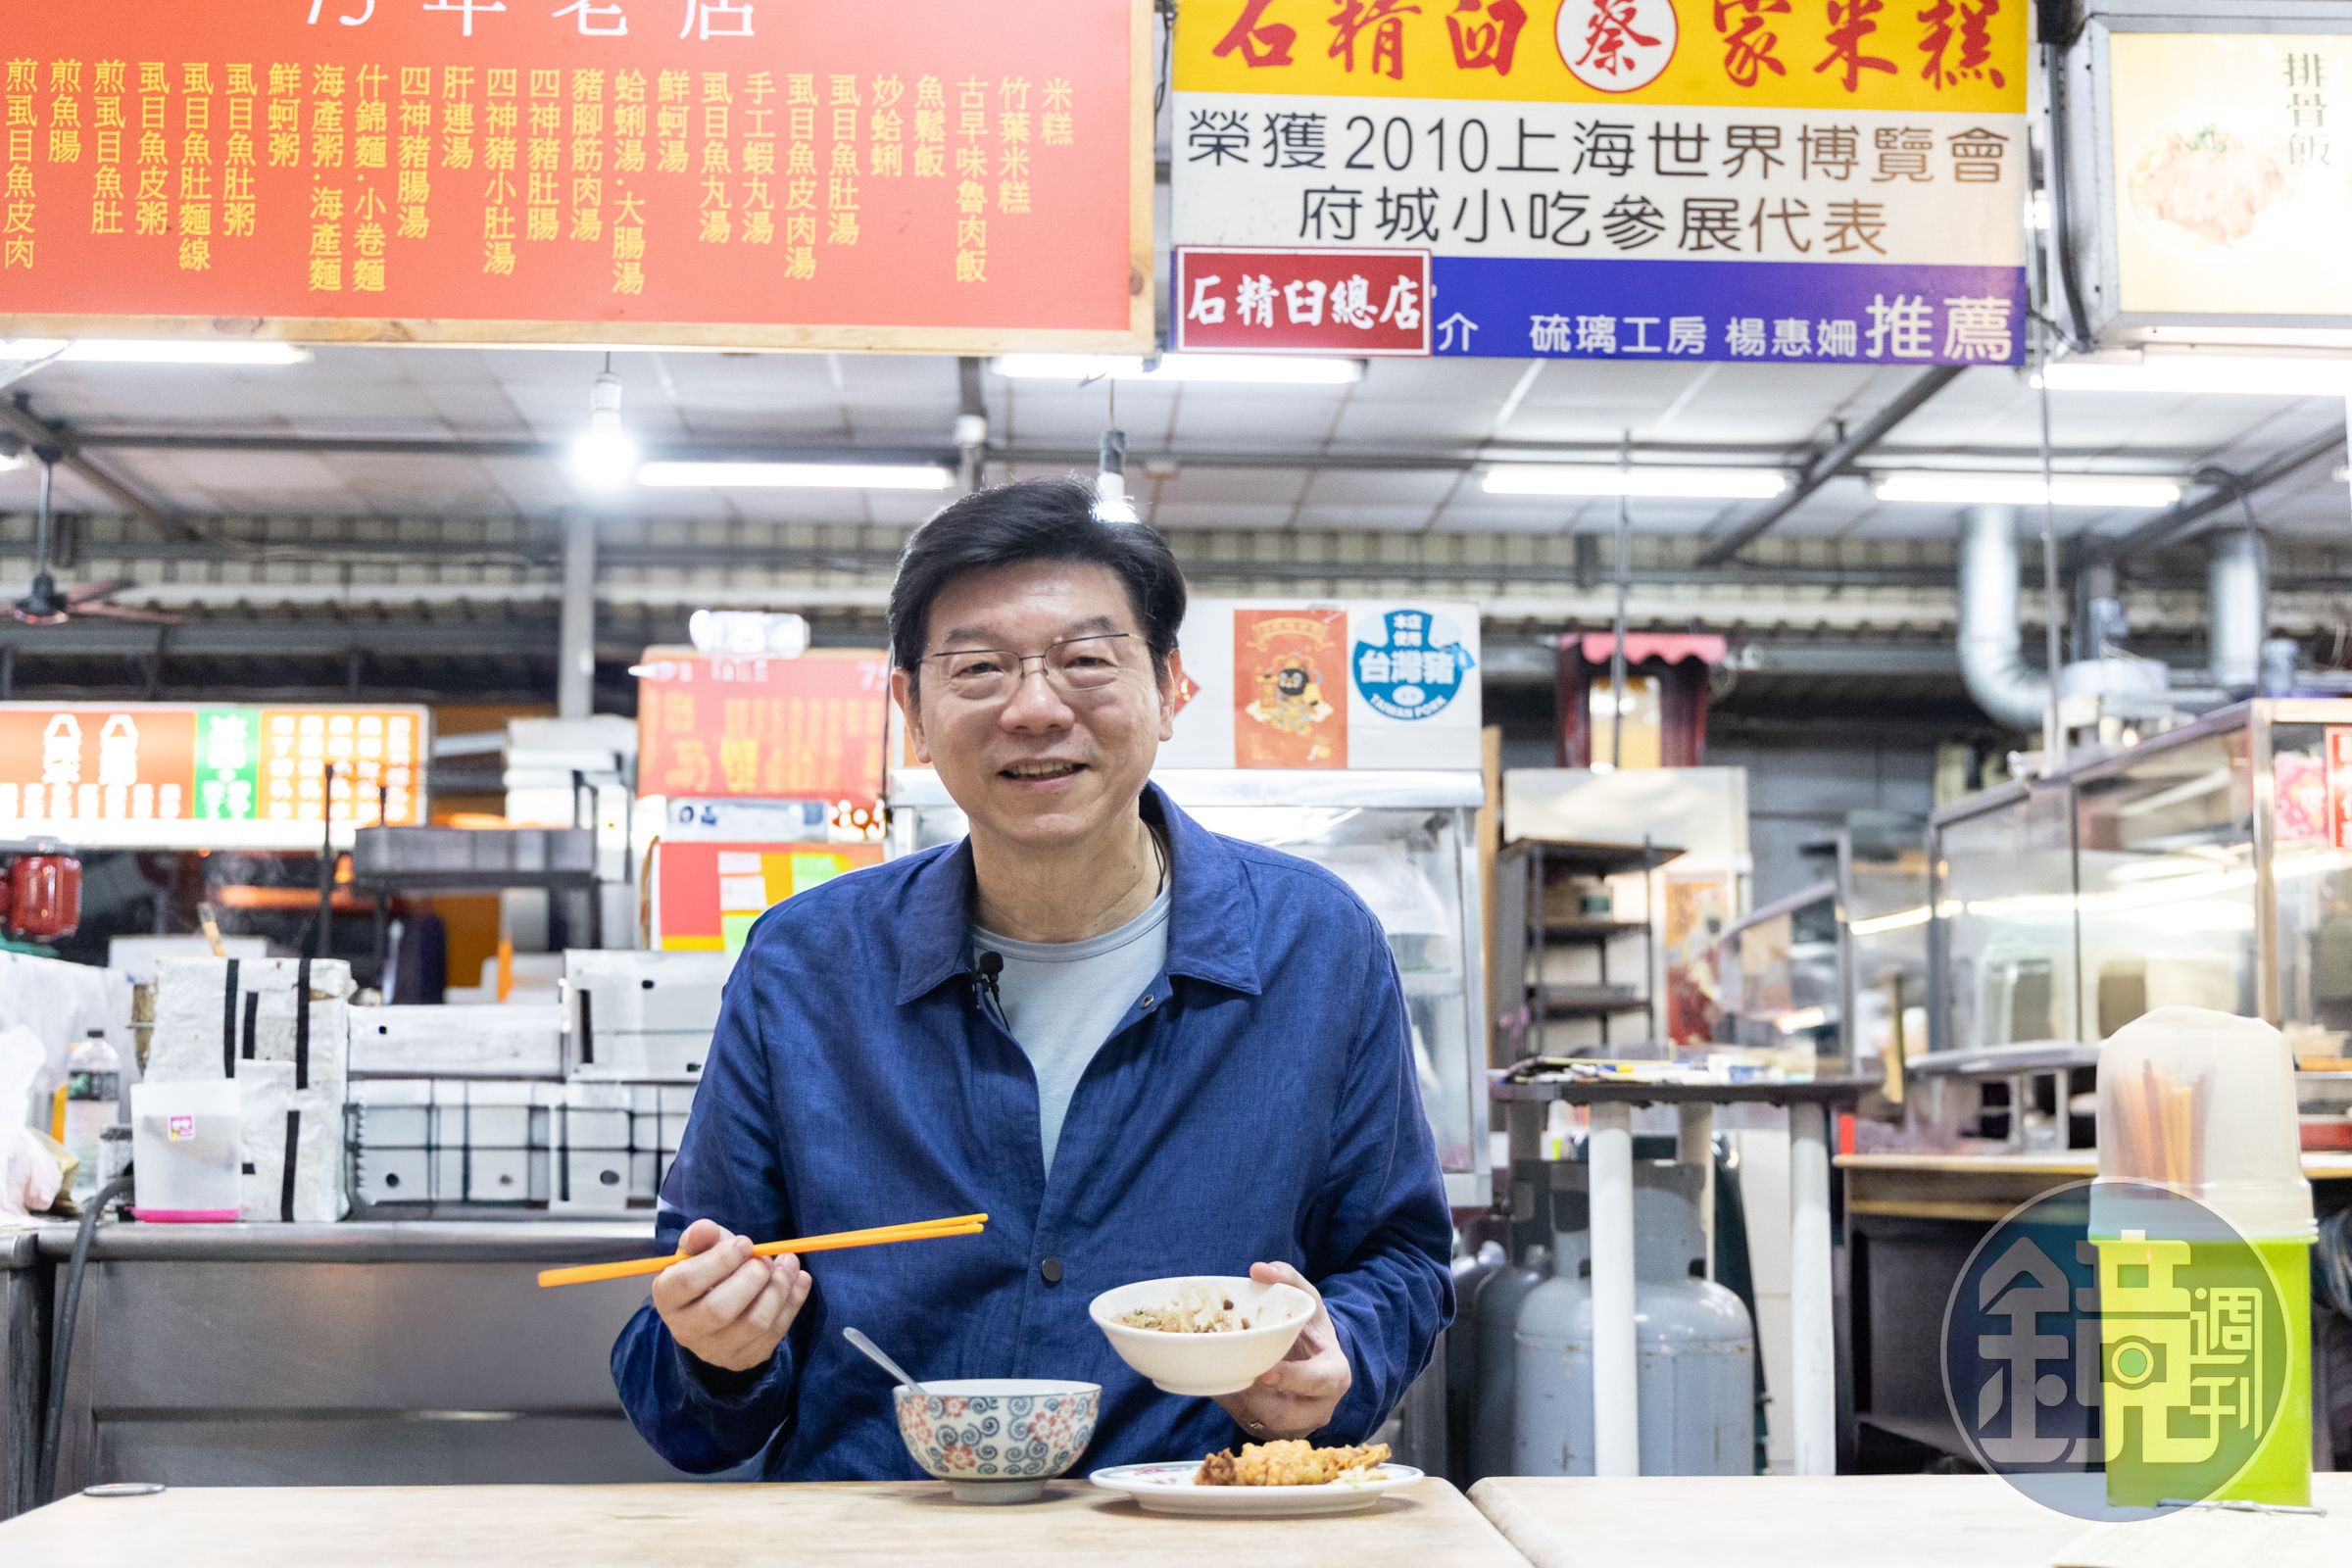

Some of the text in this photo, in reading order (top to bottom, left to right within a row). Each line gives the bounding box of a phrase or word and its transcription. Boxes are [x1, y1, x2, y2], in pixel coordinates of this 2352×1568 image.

[3, 57, 39, 270] 煎虱目魚皮肉
[47, 58, 83, 165] 煎魚腸
[90, 59, 127, 236] 煎虱目魚肚
[134, 61, 171, 237] 虱目魚皮粥
[178, 62, 215, 272] 虱目魚肚麵線
[222, 63, 259, 238] 虱目魚肚粥
[267, 62, 301, 169] 鮮蚵粥
[396, 66, 432, 240] 四神豬腸湯
[440, 65, 475, 171] 肝連湯
[482, 68, 519, 276] 四神豬小肚湯
[526, 68, 562, 242] 四神豬肚腸
[569, 68, 606, 243] 豬腳筋肉湯
[657, 69, 691, 173] 鮮蚵湯
[699, 72, 733, 244] 虱目魚丸湯
[741, 71, 776, 245] 手工蝦丸湯
[784, 73, 819, 281] 虱目魚皮肉湯
[827, 74, 861, 246] 虱目魚肚湯
[869, 74, 905, 178] 炒蛤蜊
[912, 74, 947, 178] 魚鬆飯
[955, 75, 989, 284] 古早味魯肉飯
[998, 75, 1032, 216] 竹葉米糕
[1041, 77, 1074, 146] 米糕
[1188, 108, 2009, 185] 榮獲2010上海世界博覽會
[1187, 273, 1422, 330] 石精臼總店
[1298, 185, 1887, 256] 府城小吃參展代表
[1358, 649, 1454, 685] 台灣豬
